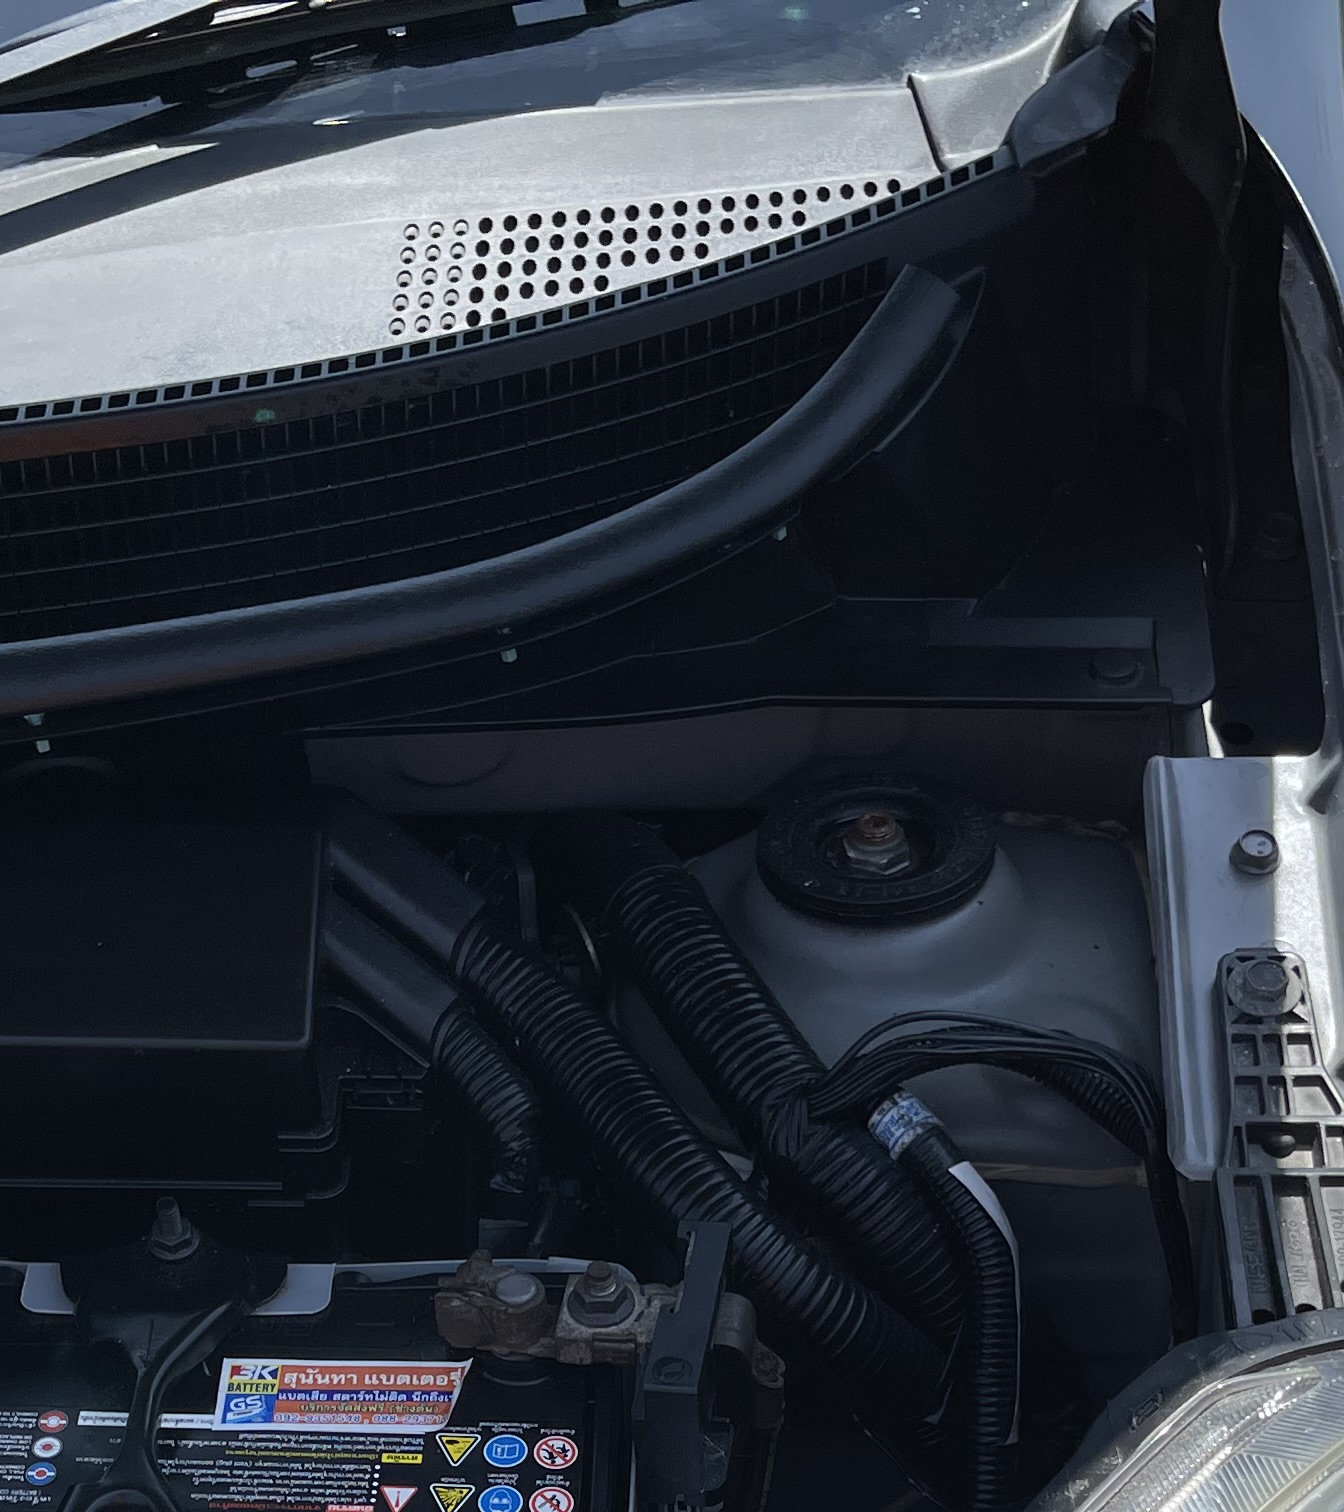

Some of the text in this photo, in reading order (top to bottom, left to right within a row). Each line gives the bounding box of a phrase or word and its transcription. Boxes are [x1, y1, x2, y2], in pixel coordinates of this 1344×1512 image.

[283, 1367, 358, 1388] สุนันทา
[226, 1382, 277, 1393] BATTERY
[229, 1394, 263, 1412] GS
